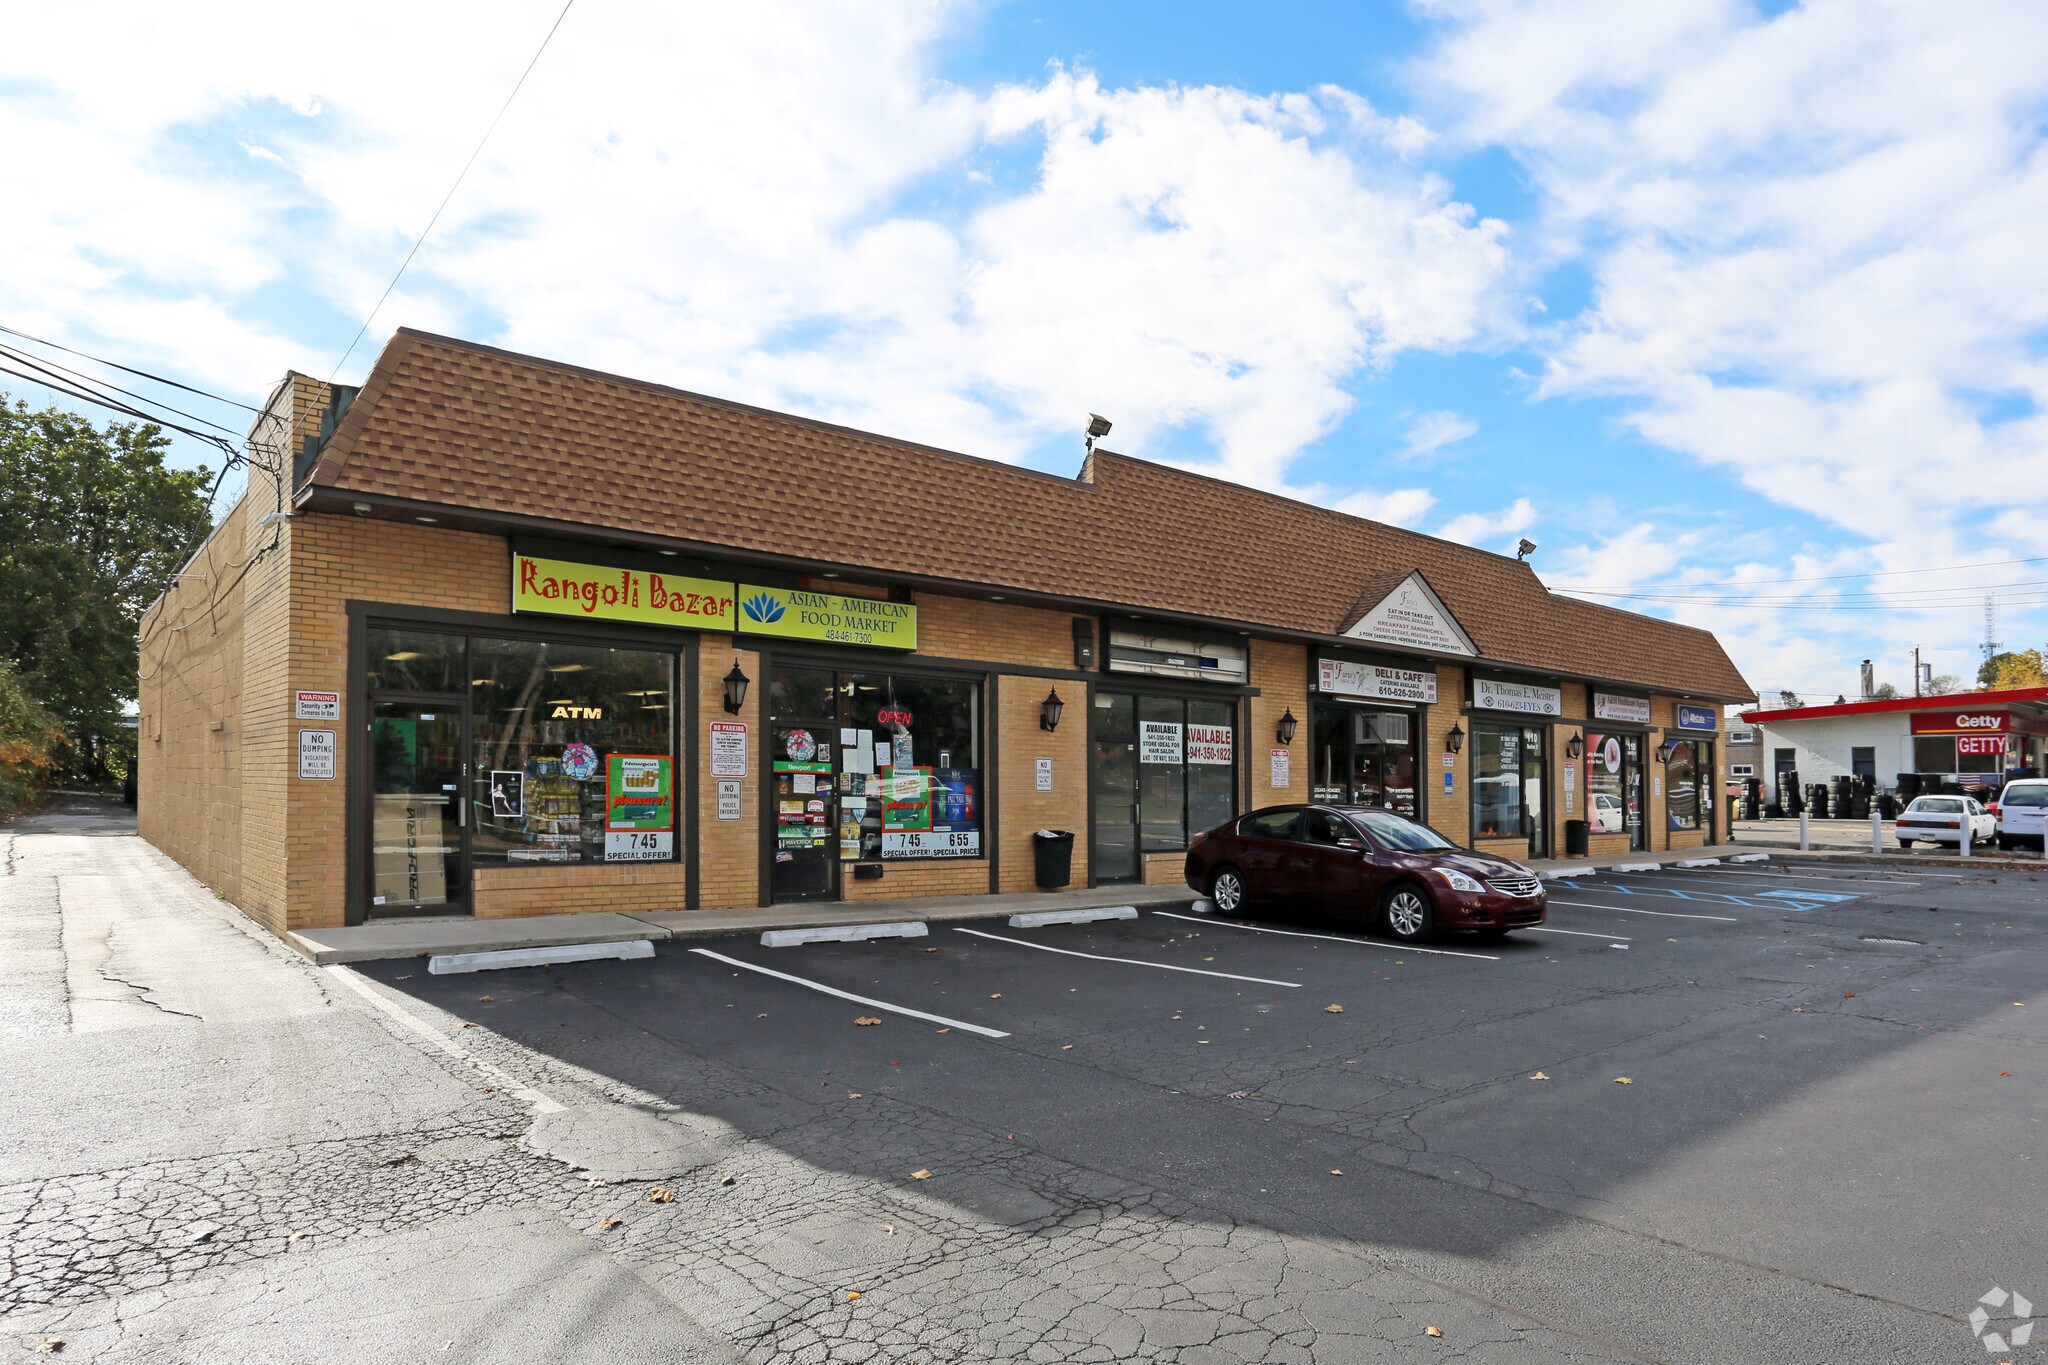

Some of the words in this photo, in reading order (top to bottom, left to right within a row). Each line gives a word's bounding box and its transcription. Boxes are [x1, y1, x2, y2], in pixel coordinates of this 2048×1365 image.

[521, 557, 639, 613] Rangoli
[650, 573, 733, 617] Bazar
[788, 592, 829, 609] ASIAN
[841, 599, 909, 619] AMERICAN
[800, 610, 842, 627] FOOD
[844, 617, 898, 633] MARKET
[1378, 621, 1409, 629] BREAKFAST
[1387, 614, 1411, 622] CATERING
[1411, 618, 1434, 627] AVAILABLE
[825, 629, 872, 644] 484-461-7300
[1375, 668, 1393, 679] DELI
[1395, 671, 1401, 680] &
[1380, 679, 1400, 687] CATERING
[300, 693, 336, 702] WARNING
[1378, 687, 1424, 700] 610-626-2900
[1481, 682, 1493, 694] Dr.
[1494, 683, 1522, 697] Thomas
[1523, 687, 1531, 698] E.
[1532, 688, 1556, 701] Meister
[301, 702, 320, 710] Security
[1497, 699, 1541, 712] 610-623-EYES
[551, 706, 602, 720] ATM
[878, 710, 912, 725] OPEN
[1956, 715, 2001, 728] Getty
[1146, 724, 1178, 735] AVAILABLE
[1187, 727, 1231, 745] AVAILABLE
[311, 734, 324, 744] NO
[1527, 733, 1538, 742] 110
[302, 745, 333, 753] DUMPING
[1959, 737, 2006, 753] GETTY
[788, 763, 811, 771] Newport
[724, 784, 734, 792] NO
[612, 793, 668, 808] pleasure!
[886, 799, 927, 811] pleasure!
[615, 834, 620, 842] $
[630, 833, 657, 849] 7.45
[900, 834, 920, 848] 7.45
[949, 833, 969, 847] 6.55
[406, 807, 420, 902] PRO-FORM
[607, 852, 641, 860] SPECIAL
[642, 851, 670, 859] OFFER!
[933, 849, 958, 857] SPECIAL
